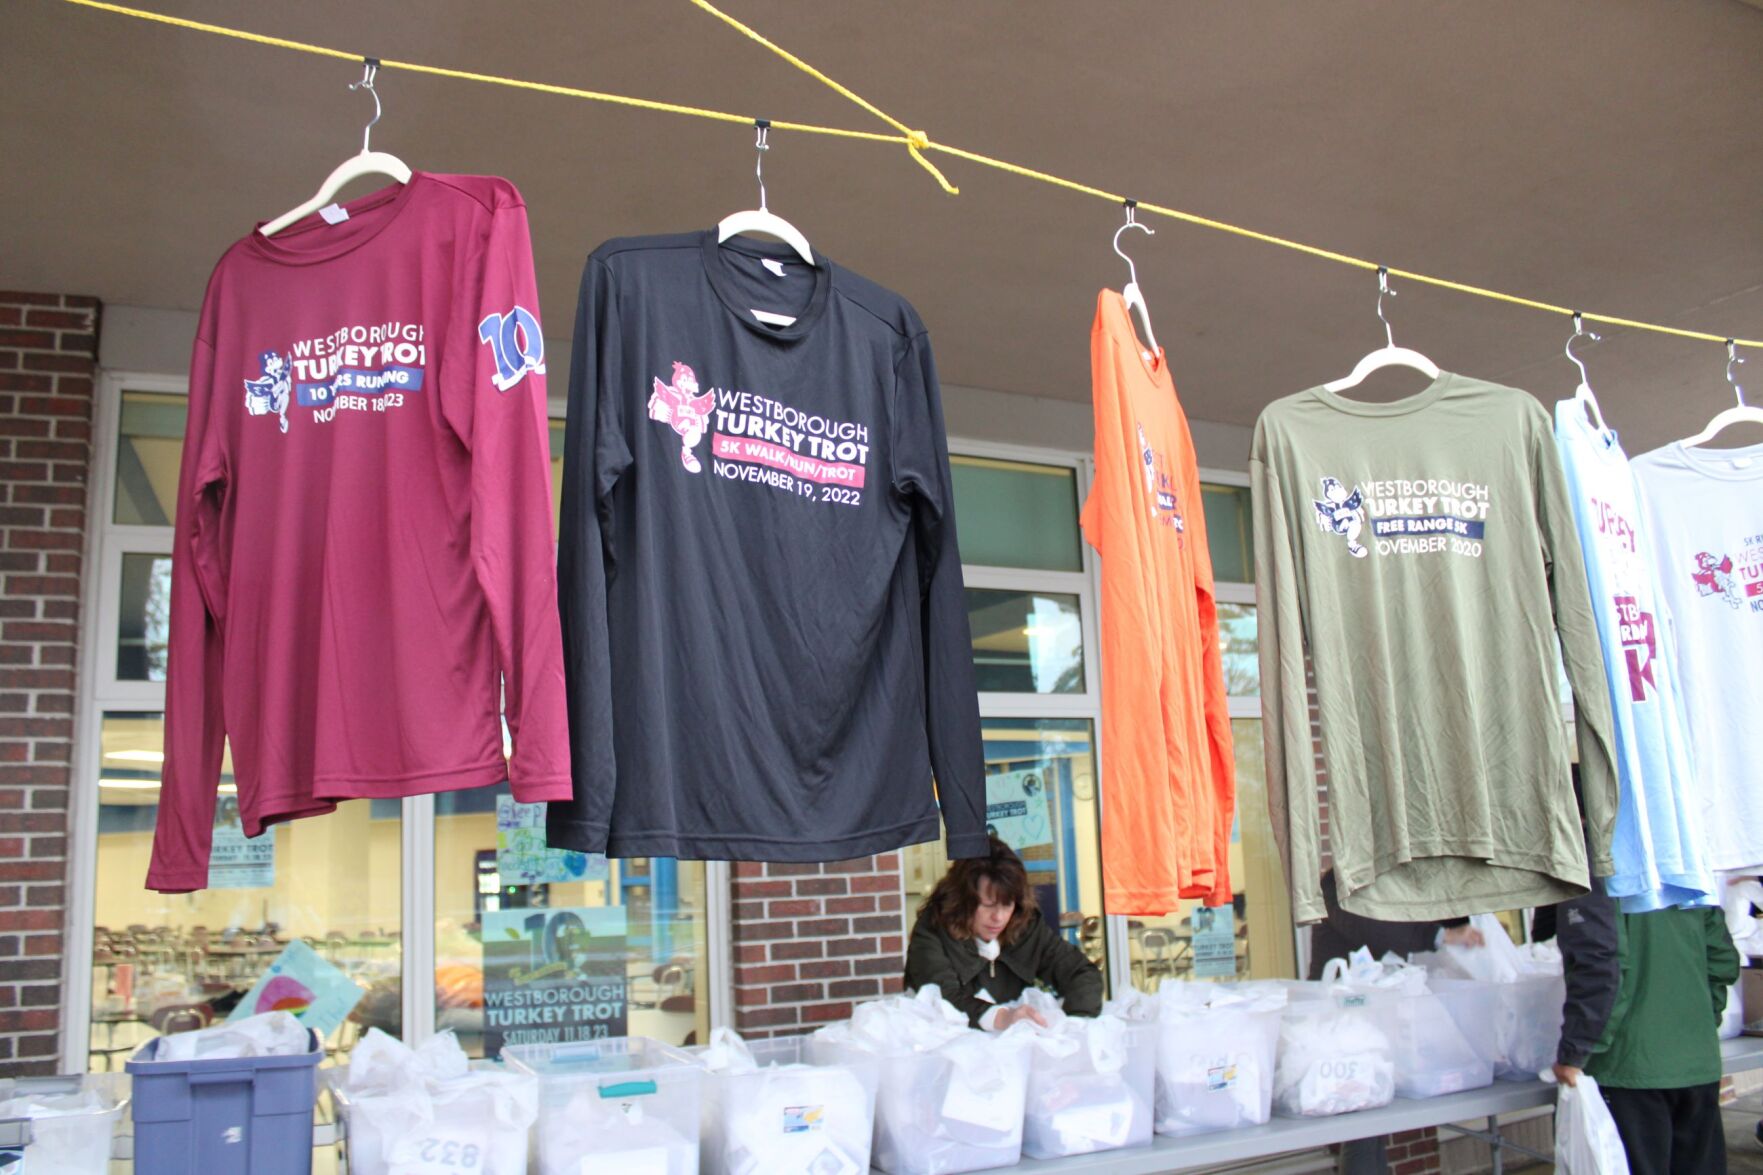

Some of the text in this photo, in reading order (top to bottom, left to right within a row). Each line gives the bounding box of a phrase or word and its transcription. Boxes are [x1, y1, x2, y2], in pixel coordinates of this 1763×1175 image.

[478, 305, 544, 383] 10
[293, 345, 379, 380] TURKEY
[310, 387, 327, 401] 10
[718, 387, 868, 443] WESTBOROUGH
[716, 409, 869, 464] TURKEY TROT
[720, 440, 740, 455] 5K
[713, 460, 861, 506] NOVEMBER 19, 2022
[1361, 479, 1488, 500] WESTBOROUGH
[1440, 497, 1490, 519] TROT
[1377, 518, 1467, 534] FREE RANGE 5K
[485, 984, 625, 1008] WESTBOROUGH
[487, 1002, 624, 1026] TURKEY TROT
[502, 1027, 560, 1047] SATURDAY
